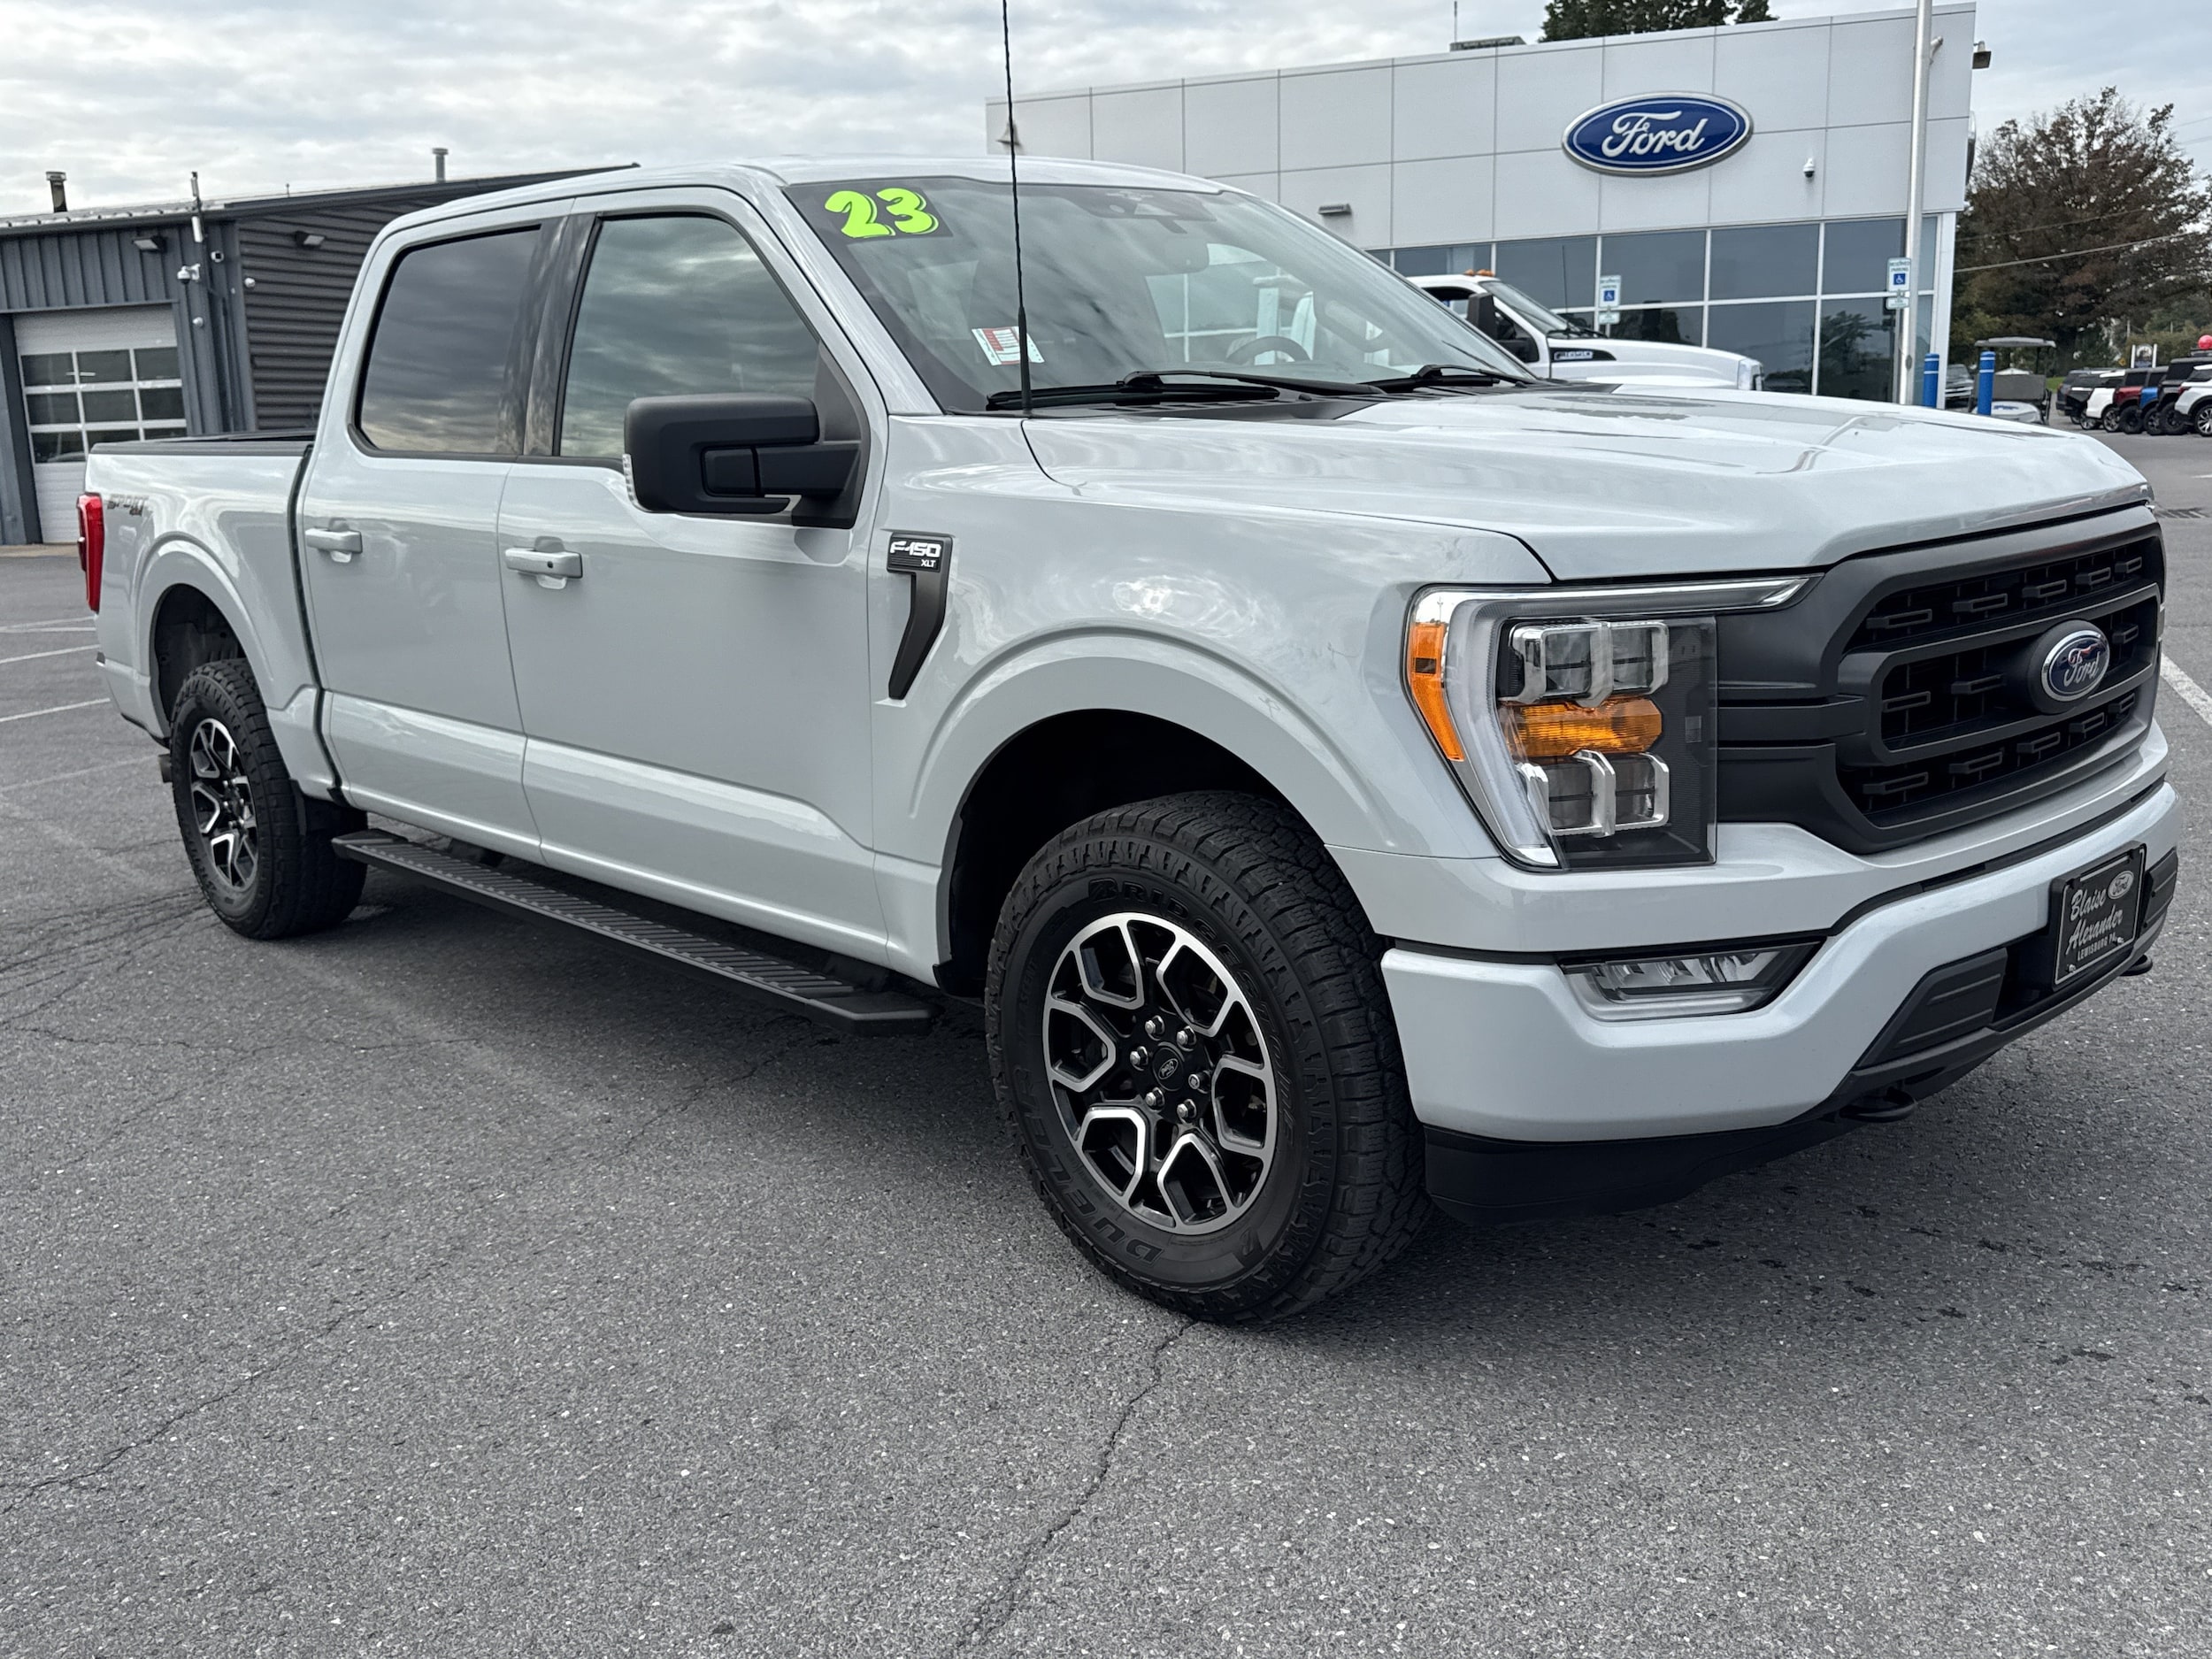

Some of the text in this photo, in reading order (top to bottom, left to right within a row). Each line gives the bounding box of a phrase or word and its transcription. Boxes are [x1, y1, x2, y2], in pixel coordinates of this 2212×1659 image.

[1601, 111, 1709, 157] Ford
[825, 188, 939, 238] 23
[889, 541, 941, 557] F-150
[920, 558, 936, 567] XLT
[2063, 643, 2101, 687] Ford
[2070, 889, 2107, 921] Blaise
[2065, 904, 2124, 956] Alexander
[2078, 936, 2108, 961] LEWISBURG
[1089, 878, 1295, 1147] BRIDGESTONE
[1013, 1067, 1164, 1266] DUELER
